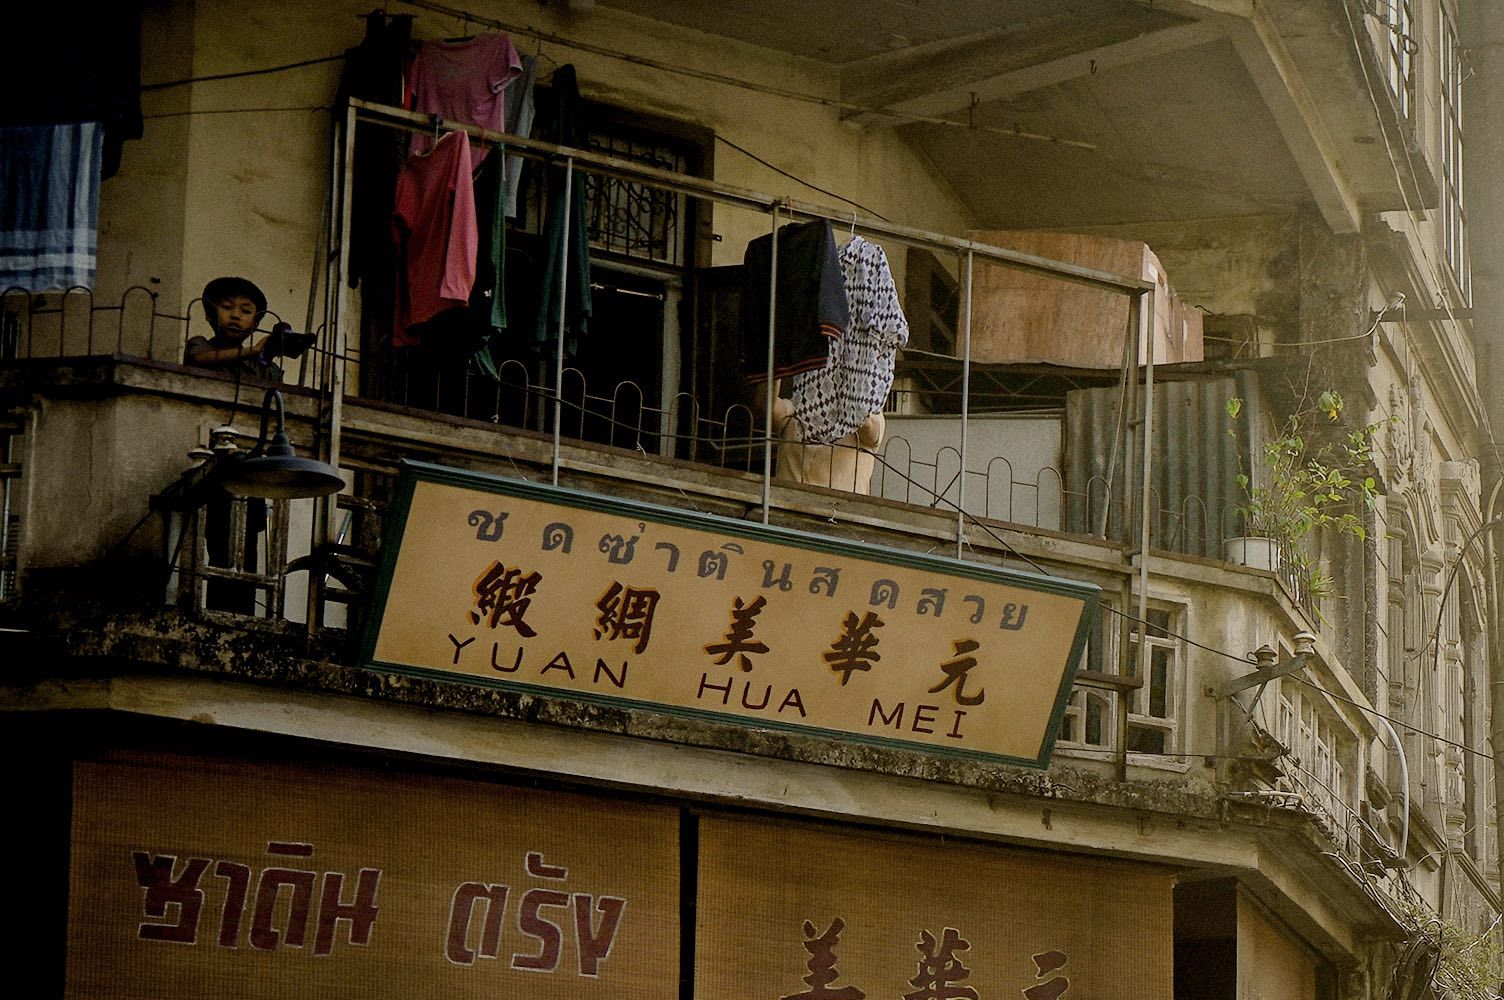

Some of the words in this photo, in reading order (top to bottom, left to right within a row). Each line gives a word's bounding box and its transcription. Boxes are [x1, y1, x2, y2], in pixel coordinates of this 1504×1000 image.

[447, 633, 629, 688] YUAN
[699, 672, 808, 717] HUA
[868, 698, 967, 740] MEI
